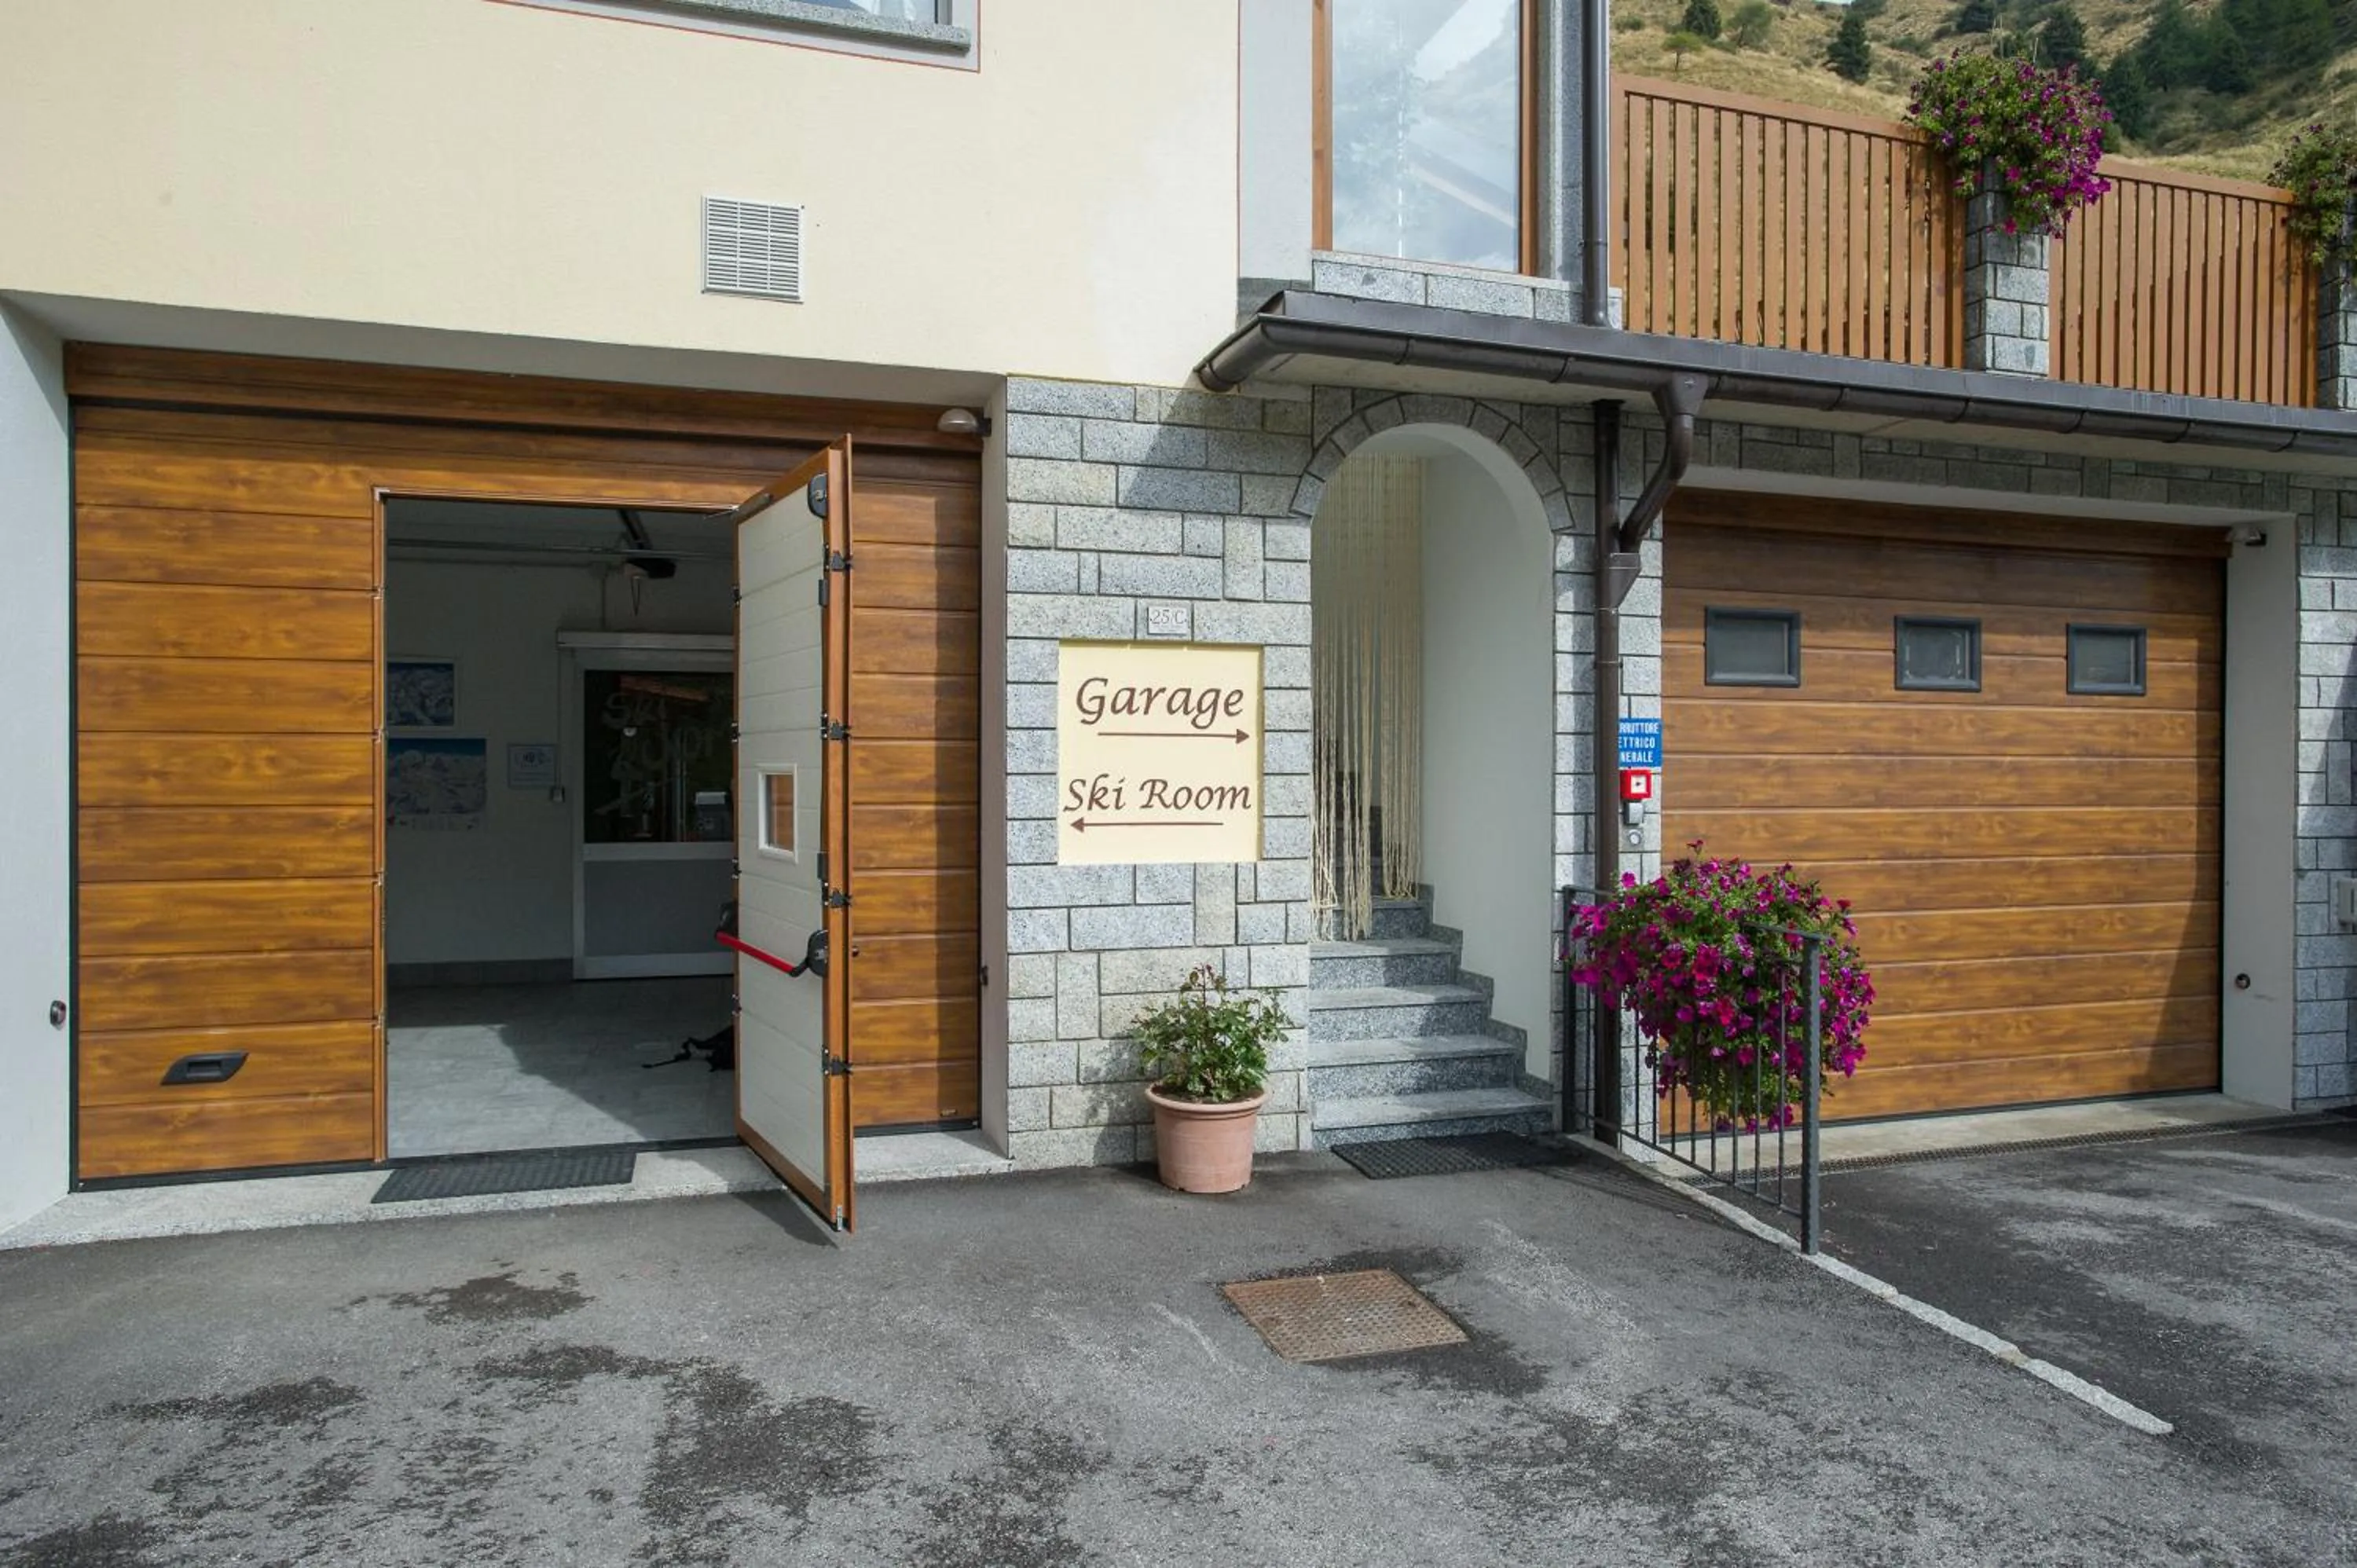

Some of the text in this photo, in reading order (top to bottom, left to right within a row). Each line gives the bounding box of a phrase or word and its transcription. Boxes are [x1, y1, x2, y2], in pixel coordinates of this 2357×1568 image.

[1076, 677, 1244, 730] Garage
[1063, 773, 1252, 812] Ski Room
